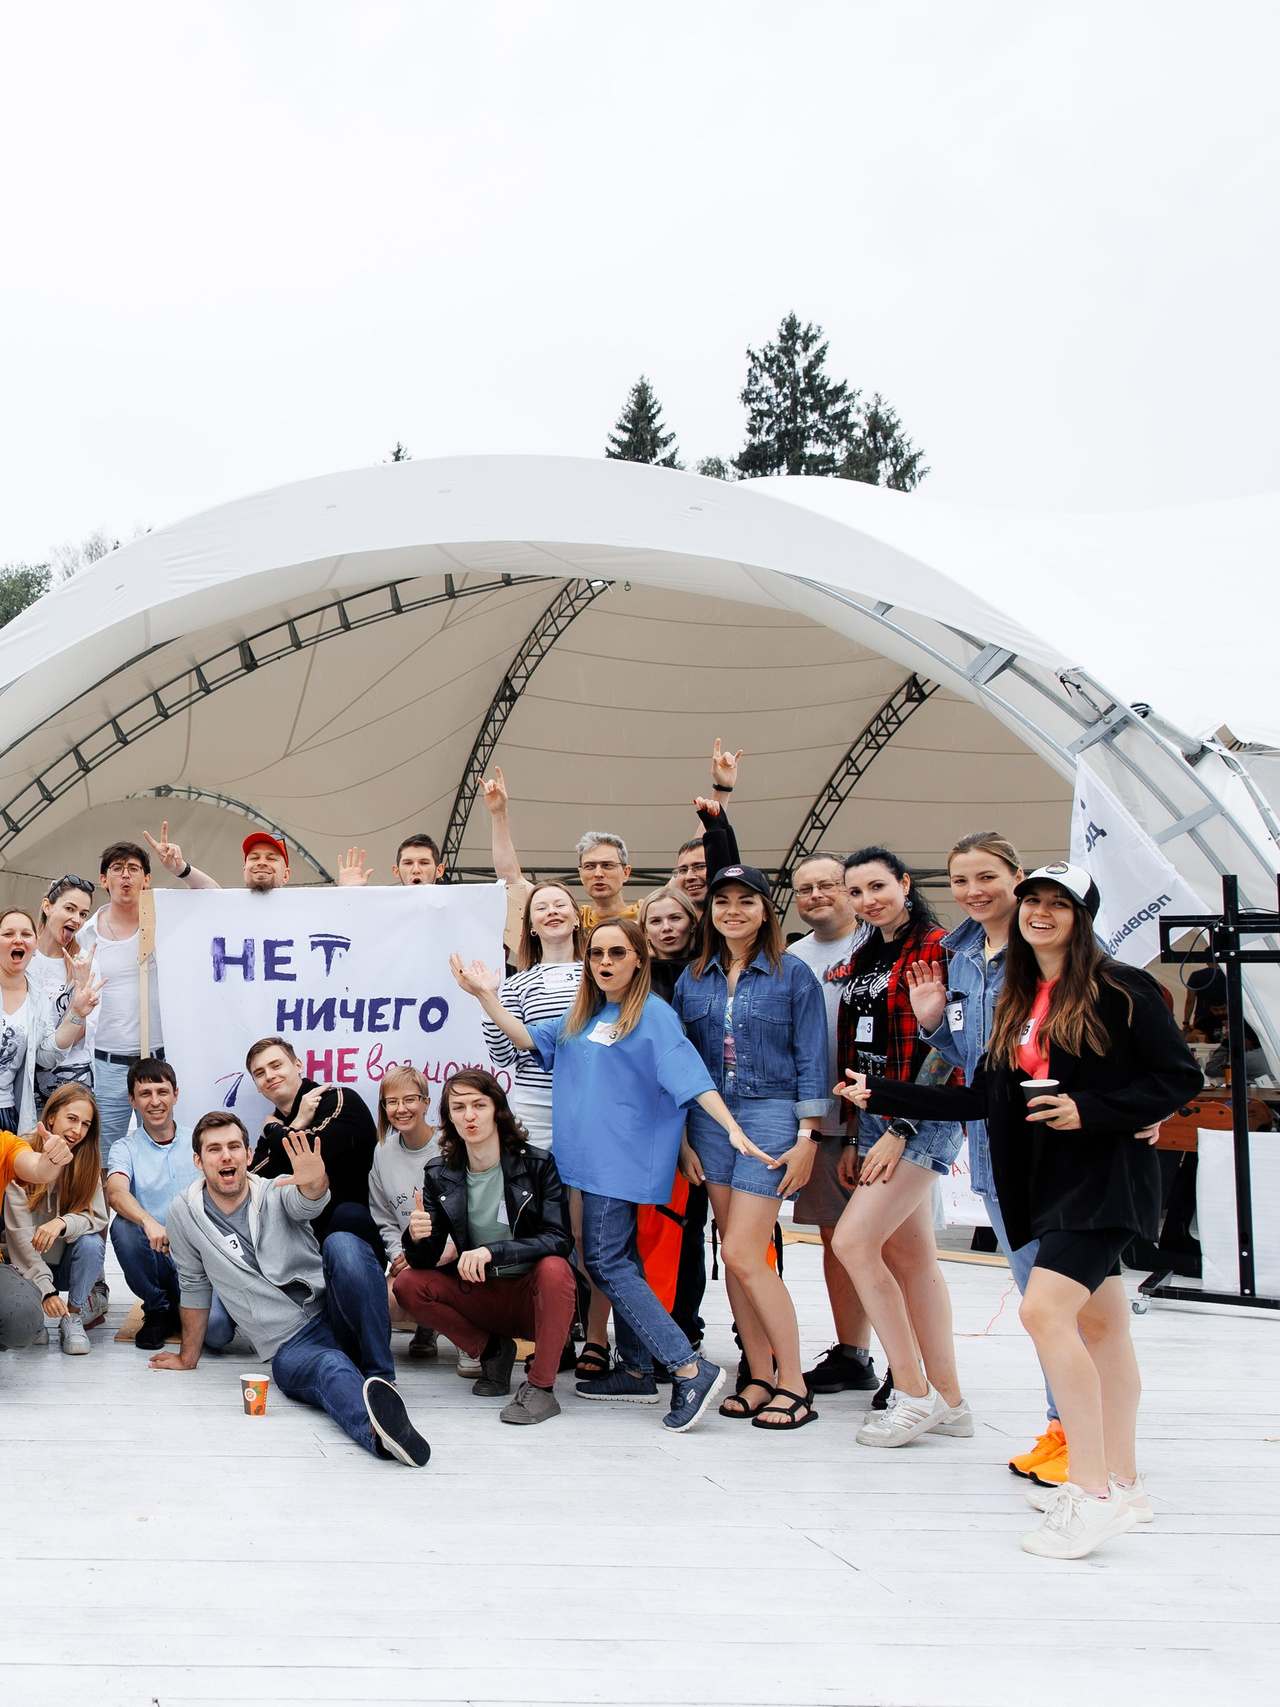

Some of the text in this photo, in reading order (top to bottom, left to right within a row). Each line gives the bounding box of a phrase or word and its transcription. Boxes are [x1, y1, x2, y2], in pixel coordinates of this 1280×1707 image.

[210, 933, 351, 982] НЕТ
[566, 973, 574, 981] 3
[59, 984, 65, 992] 3
[276, 996, 449, 1033] НИЧЕГО
[954, 1010, 963, 1021] 3
[866, 1022, 872, 1033] 3
[609, 1030, 618, 1039] 3
[229, 1240, 238, 1250] 3
